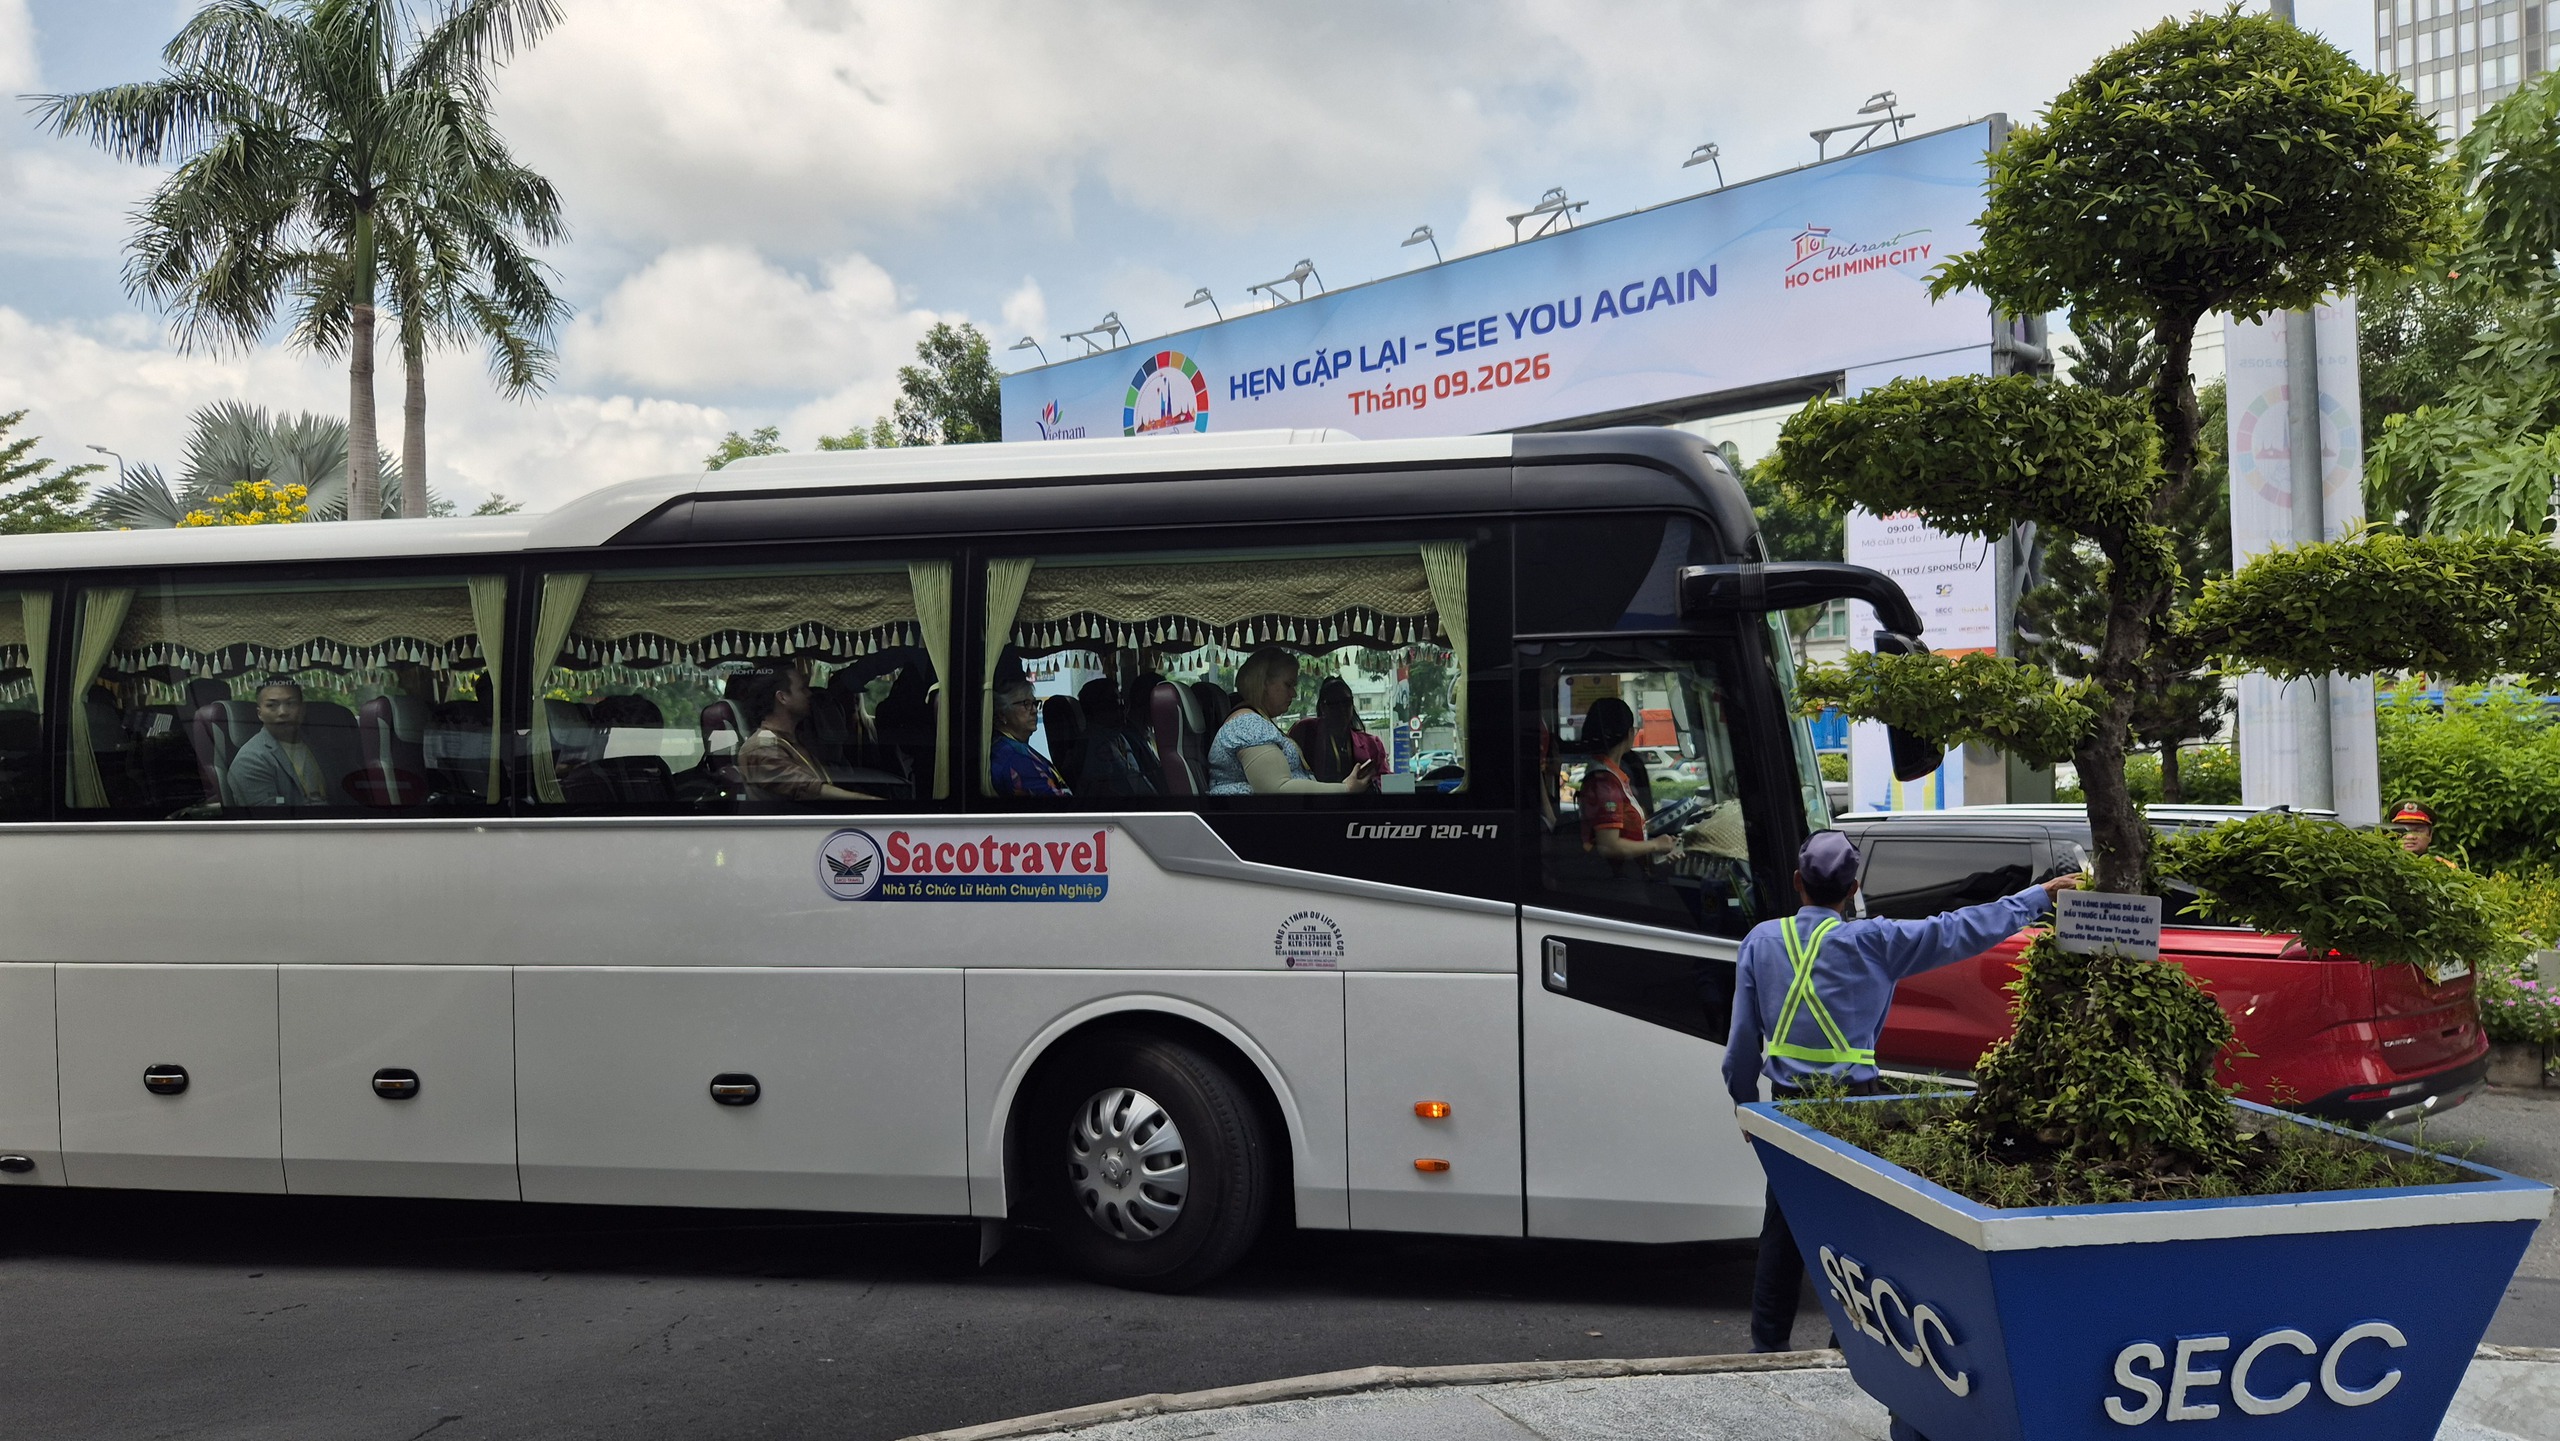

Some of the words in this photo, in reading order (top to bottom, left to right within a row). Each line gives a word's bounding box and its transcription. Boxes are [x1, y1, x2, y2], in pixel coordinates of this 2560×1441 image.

[1827, 229, 1932, 260] Vibrant
[1784, 269, 1810, 290] HO
[1812, 264, 1841, 284] CHI
[1843, 255, 1888, 279] MINH
[1889, 244, 1932, 267] CITY
[1229, 364, 1286, 401] HẸN
[1292, 350, 1353, 388] GẶP
[1358, 335, 1406, 374] LẠI
[1435, 315, 1499, 357] SEE
[1504, 296, 1583, 340] YOU
[1590, 263, 1718, 324] AGAIN
[1348, 381, 1428, 416] Tháng
[1432, 353, 1551, 399] 09.2026
[1887, 524, 1914, 534] 09:00
[1909, 534, 1922, 543] do
[1887, 568, 1900, 577] TÀI
[1901, 566, 1921, 576] TRỢ
[1927, 561, 1978, 573] SPONSORS
[1346, 821, 1428, 839] Cruizer
[886, 830, 1108, 874] Sacotravel
[882, 882, 906, 896] Nhà
[908, 880, 922, 896] Tổ
[926, 882, 957, 896] Chức
[959, 881, 974, 896] Lữ
[976, 881, 1007, 896] Hành
[1010, 882, 1056, 899] Chuyên
[1058, 882, 1102, 899] Nghiệp
[2071, 899, 2082, 907] VUI
[2100, 901, 2121, 911] KHÔNG
[2134, 903, 2147, 912] RÁC
[1281, 919, 1291, 930] TY
[1289, 911, 1308, 923] TNHH
[2078, 911, 2098, 920] THUỐC
[2059, 931, 2086, 941] Cigarette
[2129, 938, 2145, 946] Plant
[2075, 923, 2084, 931] Do
[2115, 927, 2131, 935] Trash
[1819, 1244, 1971, 1398] SECC
[2102, 1320, 2409, 1427] SECC
